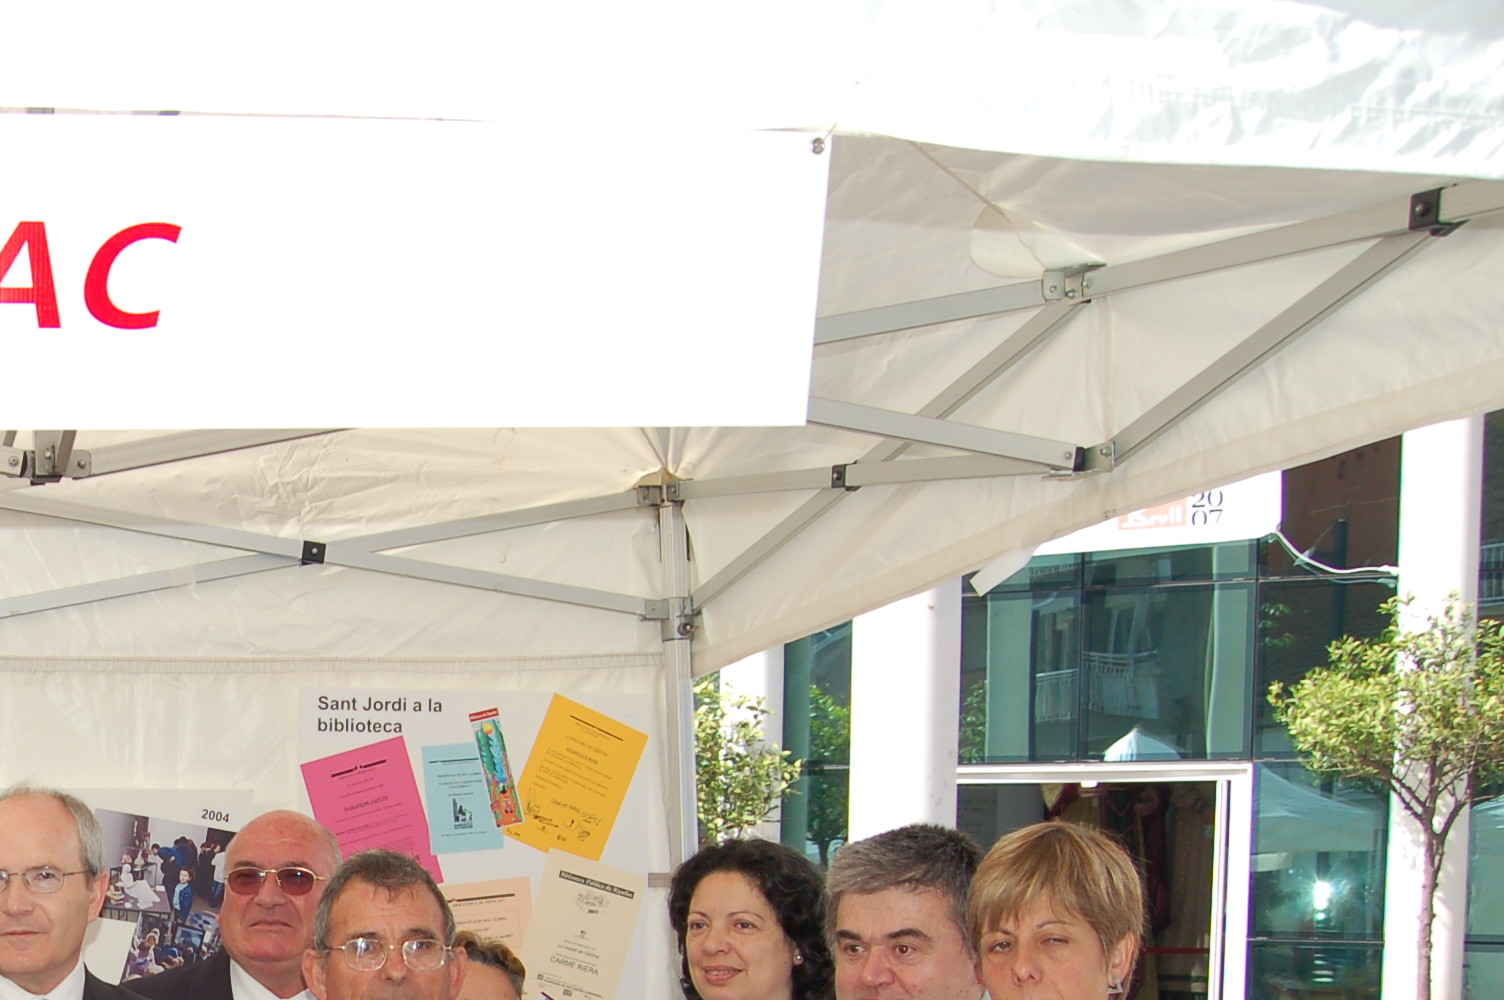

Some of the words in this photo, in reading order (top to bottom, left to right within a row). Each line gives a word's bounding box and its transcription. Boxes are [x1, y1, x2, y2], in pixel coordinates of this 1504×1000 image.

[318, 696, 357, 711] Sant
[363, 697, 407, 712] Jordi
[413, 701, 422, 712] a
[428, 698, 442, 713] la
[317, 718, 402, 733] biblioteca
[201, 808, 230, 823] 2004
